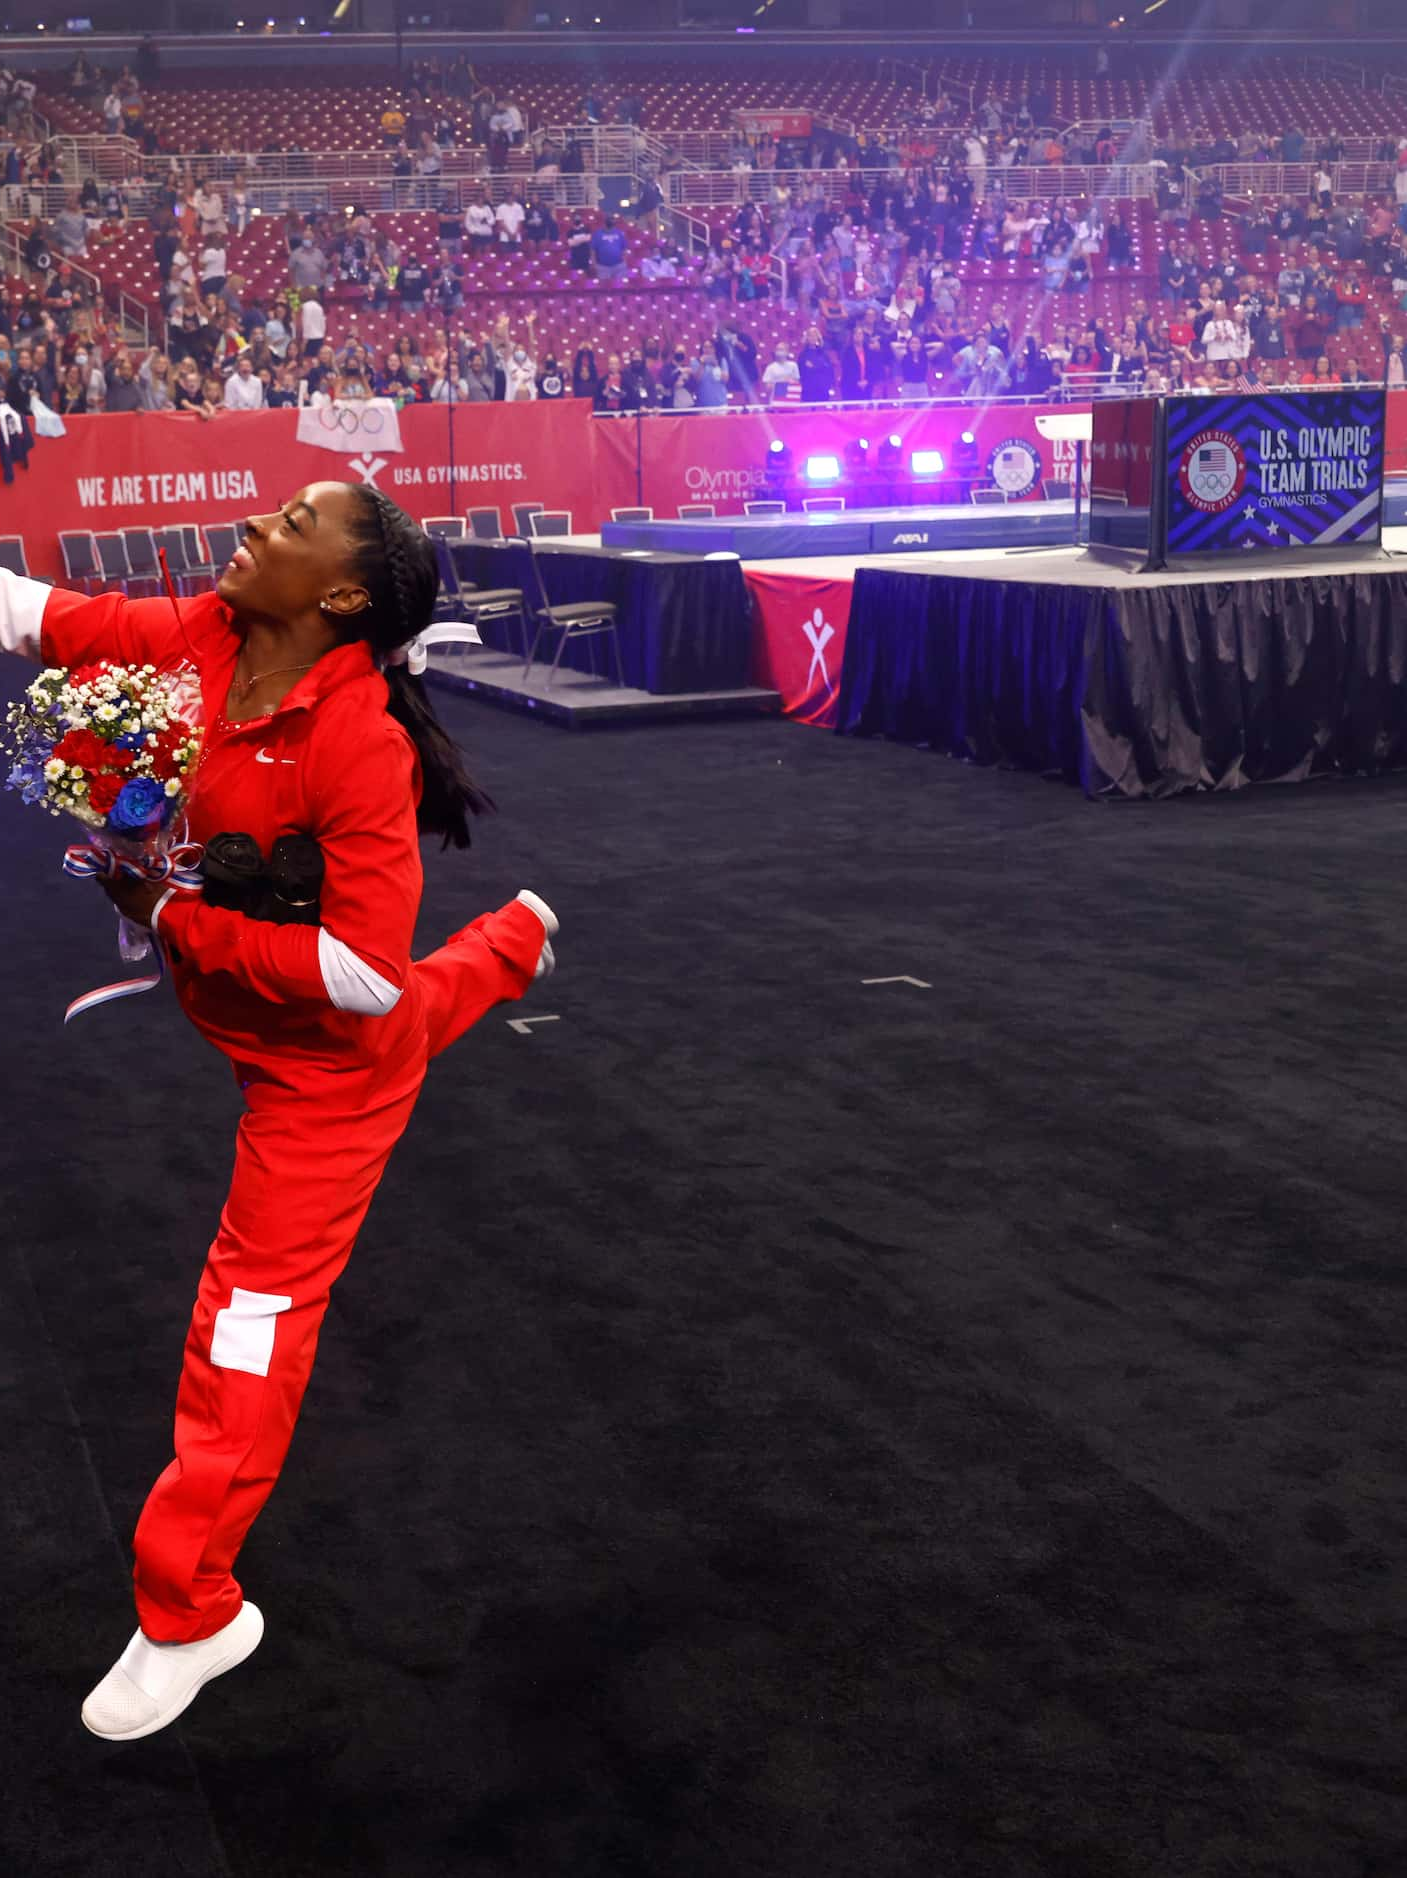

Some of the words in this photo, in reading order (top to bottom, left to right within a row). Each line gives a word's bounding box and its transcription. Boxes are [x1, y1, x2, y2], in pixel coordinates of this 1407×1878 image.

[1259, 429, 1292, 461] U.S.
[1298, 425, 1371, 459] OLYMPIC
[77, 477, 107, 507] WE
[111, 475, 144, 506] ARE
[147, 472, 207, 503] TEAM
[212, 470, 258, 499] USA
[393, 467, 423, 485] USA
[1259, 462, 1306, 494] TEAM
[1311, 458, 1368, 491] TRIALS
[1258, 494, 1328, 509] GYMNASTICS
